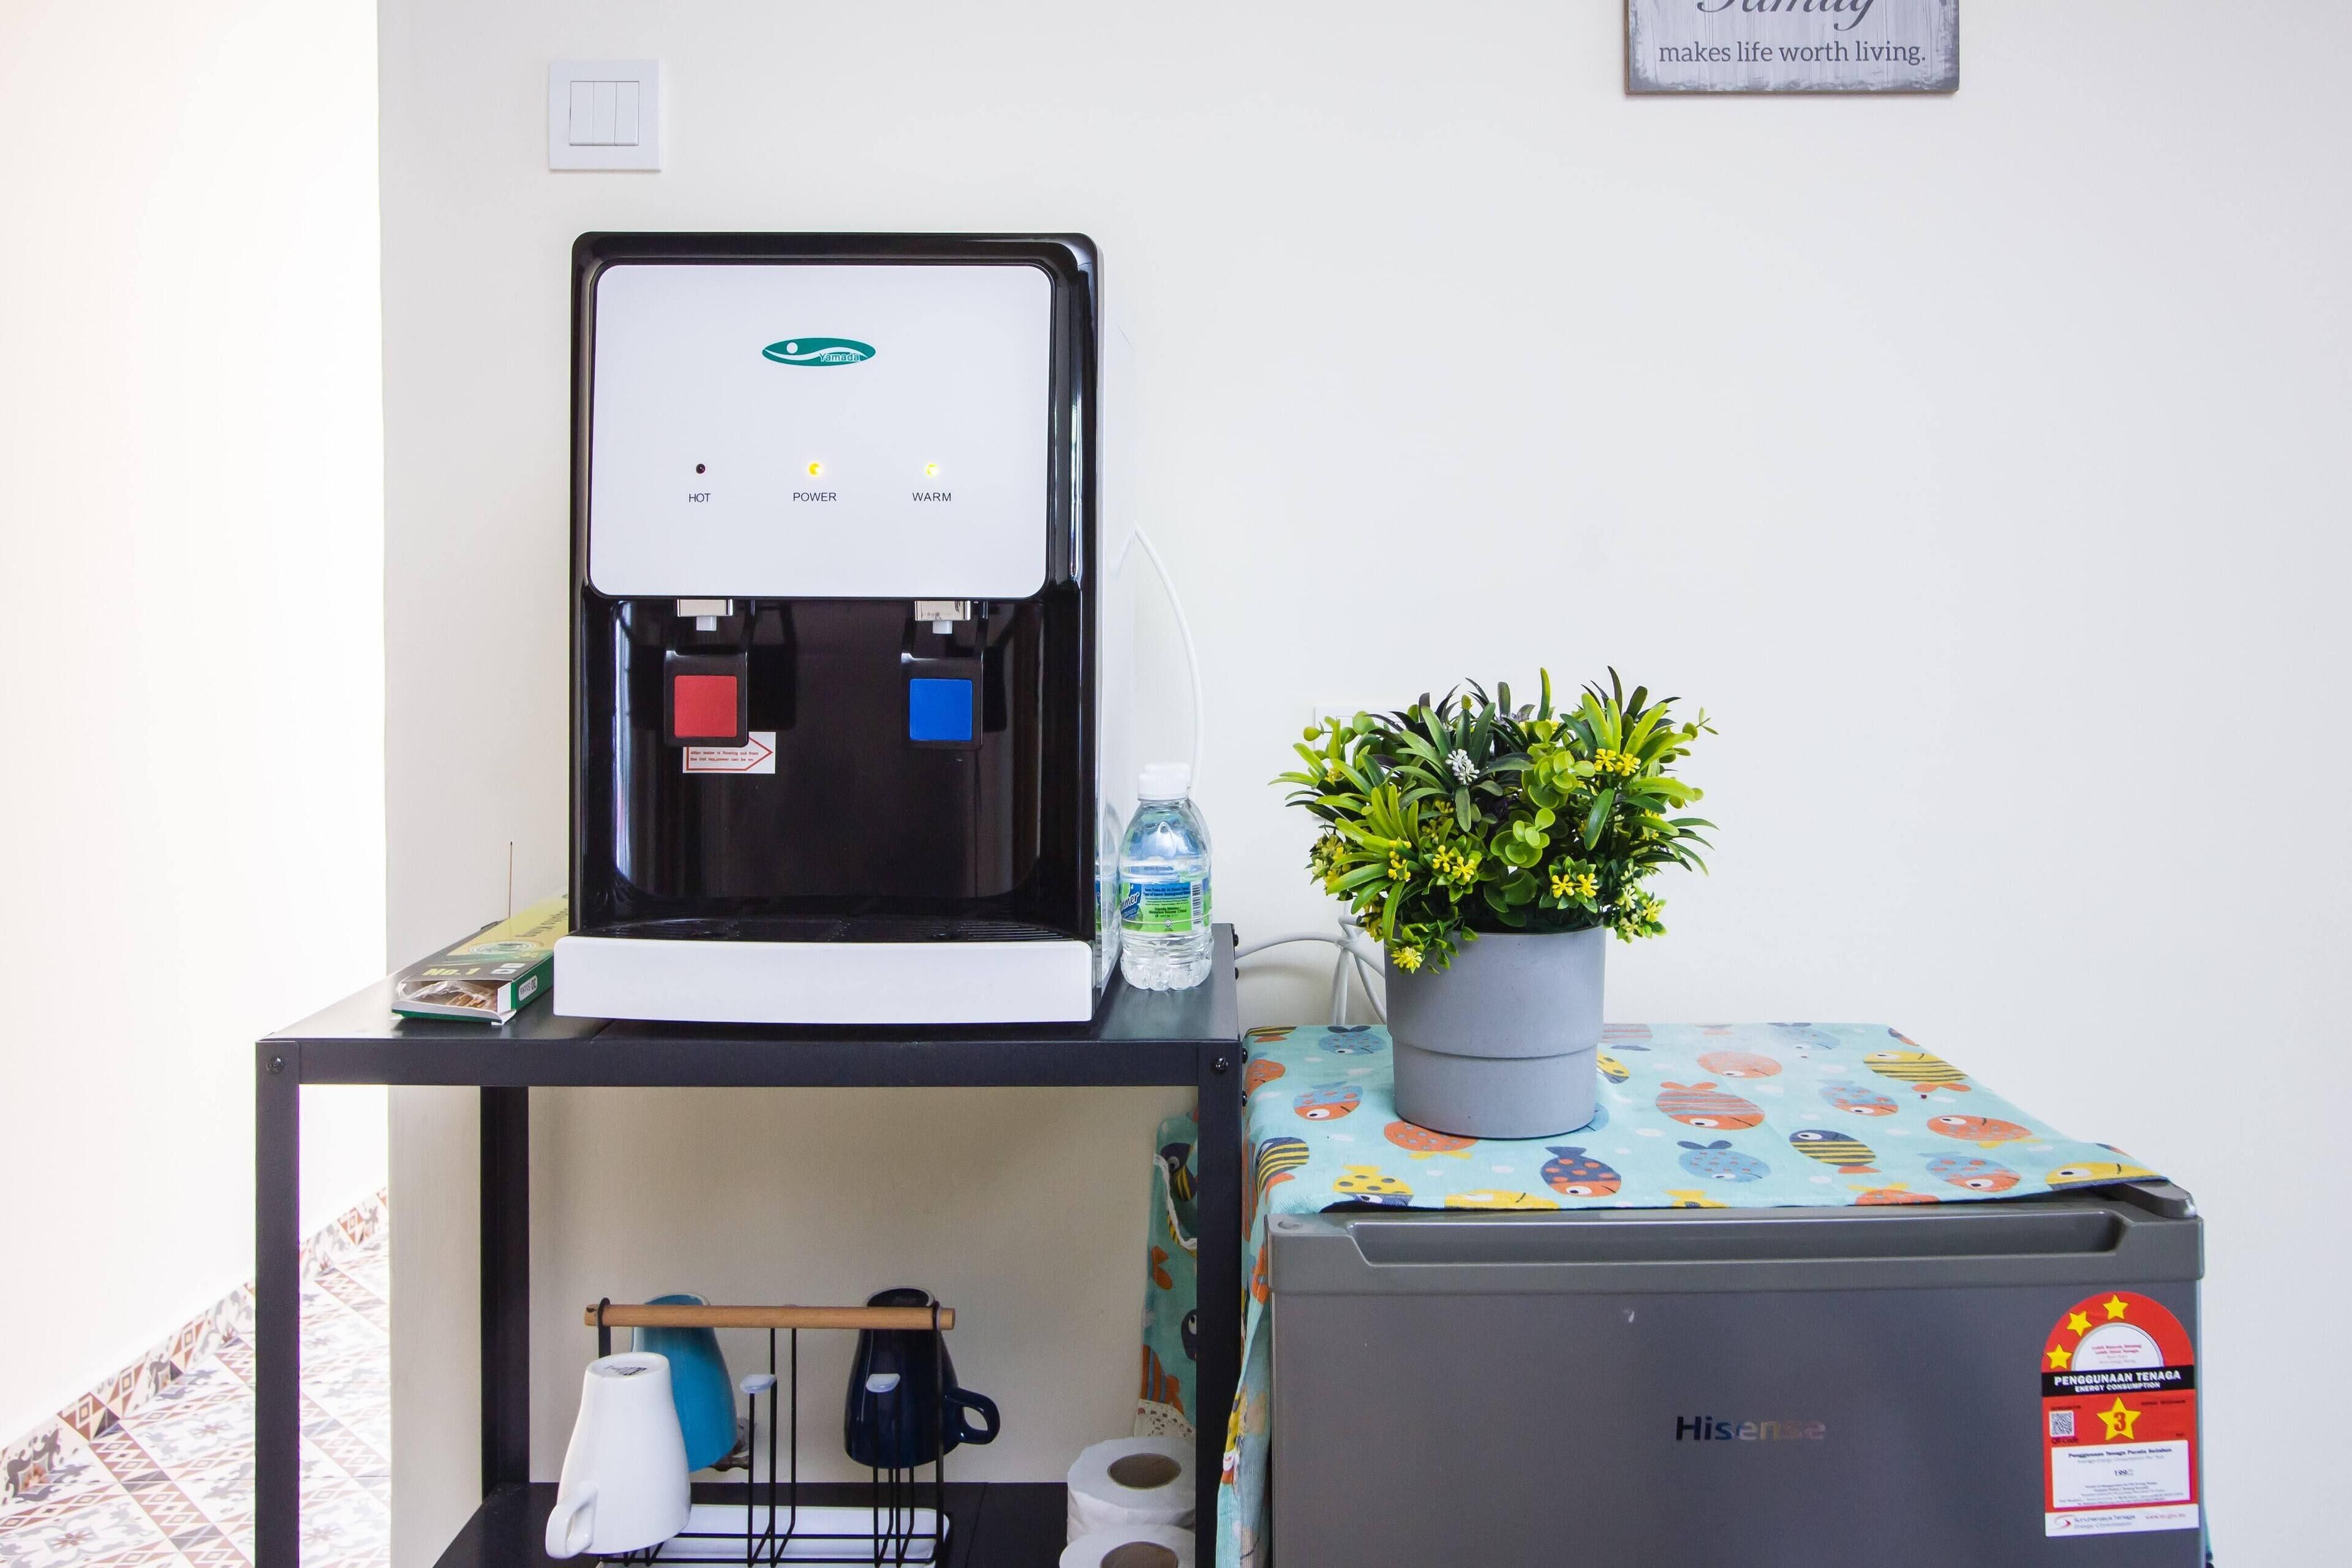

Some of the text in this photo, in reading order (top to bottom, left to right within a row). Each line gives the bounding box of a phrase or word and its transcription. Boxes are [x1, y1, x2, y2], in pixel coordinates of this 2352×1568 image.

[1697, 0, 1872, 31] amy
[1659, 40, 1926, 66] makes life worth living.
[819, 353, 861, 362] Yamada
[688, 493, 711, 503] HOT
[793, 492, 837, 502] POWER
[912, 492, 952, 502] WARM
[2054, 1370, 2182, 1386] PENGGUNAAN TENAGA
[2074, 1381, 2161, 1393] ENERGY CONSUMPTION
[1676, 1415, 1826, 1441] Hisense
[2113, 1411, 2127, 1431] 3
